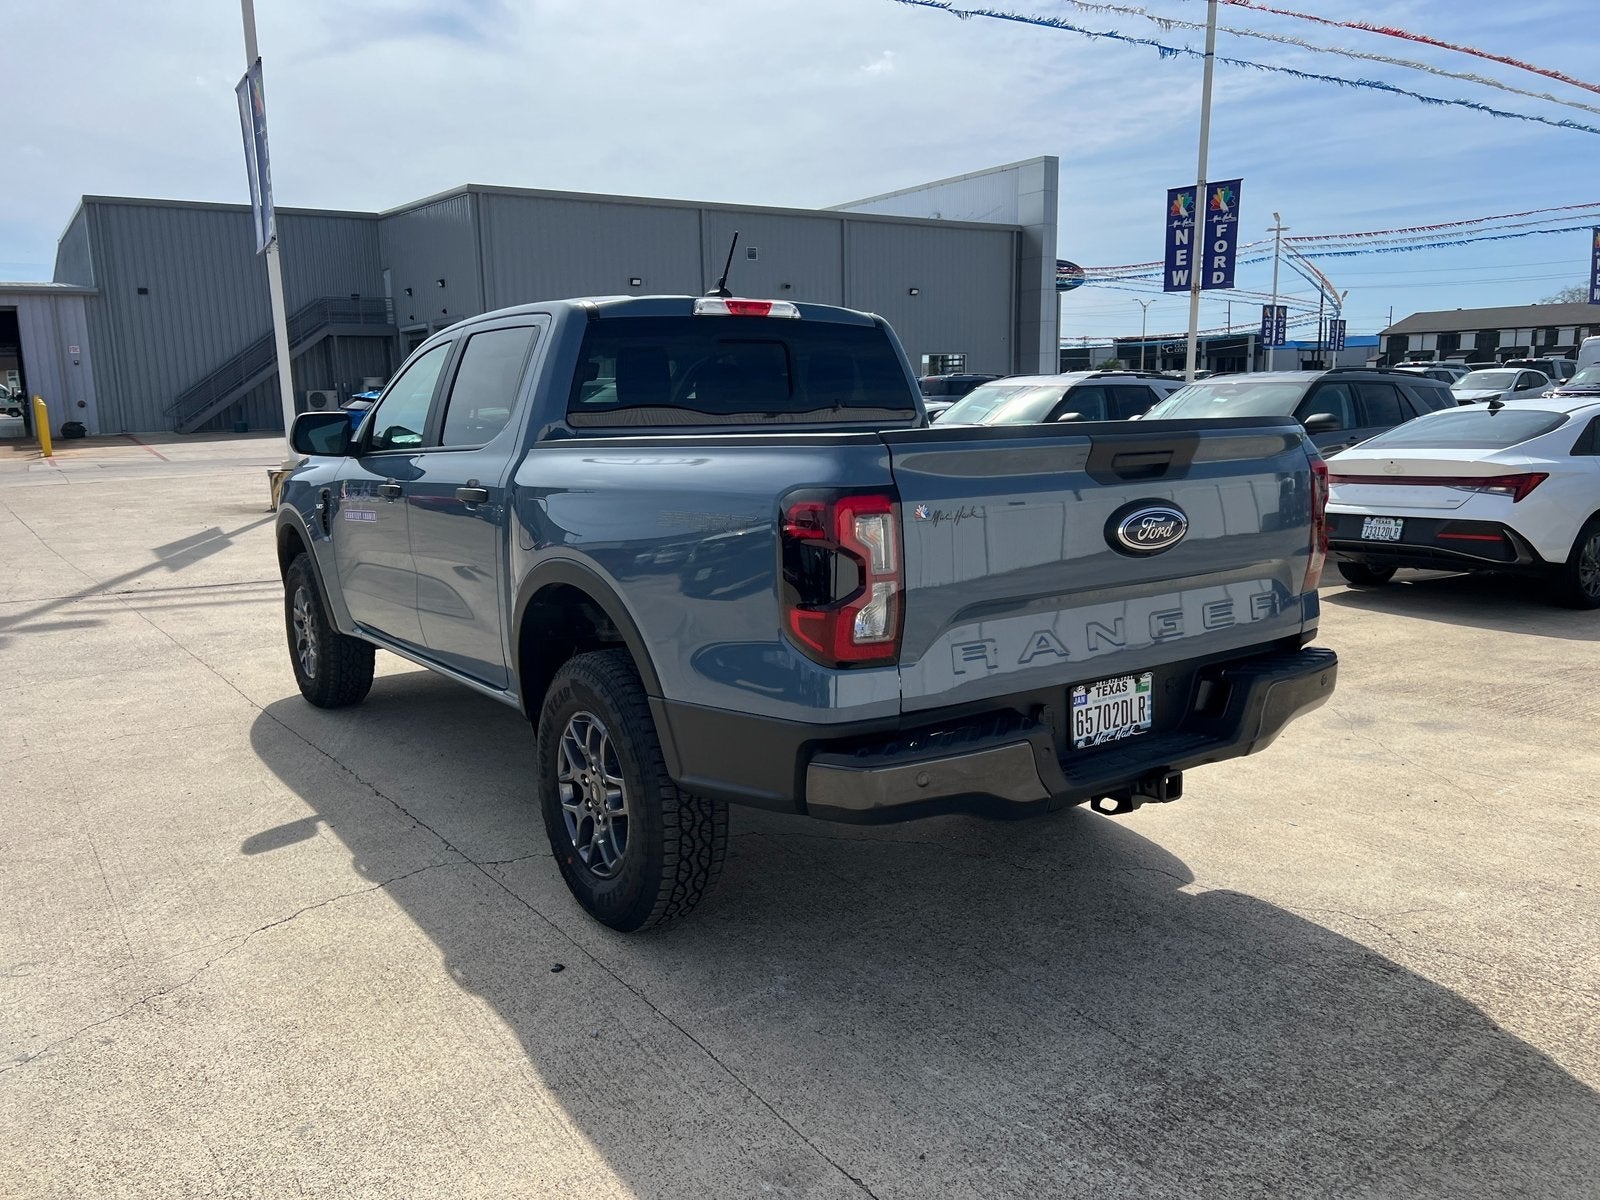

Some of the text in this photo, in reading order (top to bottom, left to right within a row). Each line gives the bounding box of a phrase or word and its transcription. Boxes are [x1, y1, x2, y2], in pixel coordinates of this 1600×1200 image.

[1172, 229, 1189, 286] NEW
[1212, 224, 1228, 284] FORD
[1263, 321, 1271, 344] NEW
[1137, 516, 1175, 541] Ford
[950, 590, 1281, 676] RANGER
[1073, 695, 1086, 706] JAN
[1096, 681, 1128, 698] TEXAS
[1076, 695, 1146, 737] 65702DLR
[1093, 725, 1142, 746] Mac Haik
